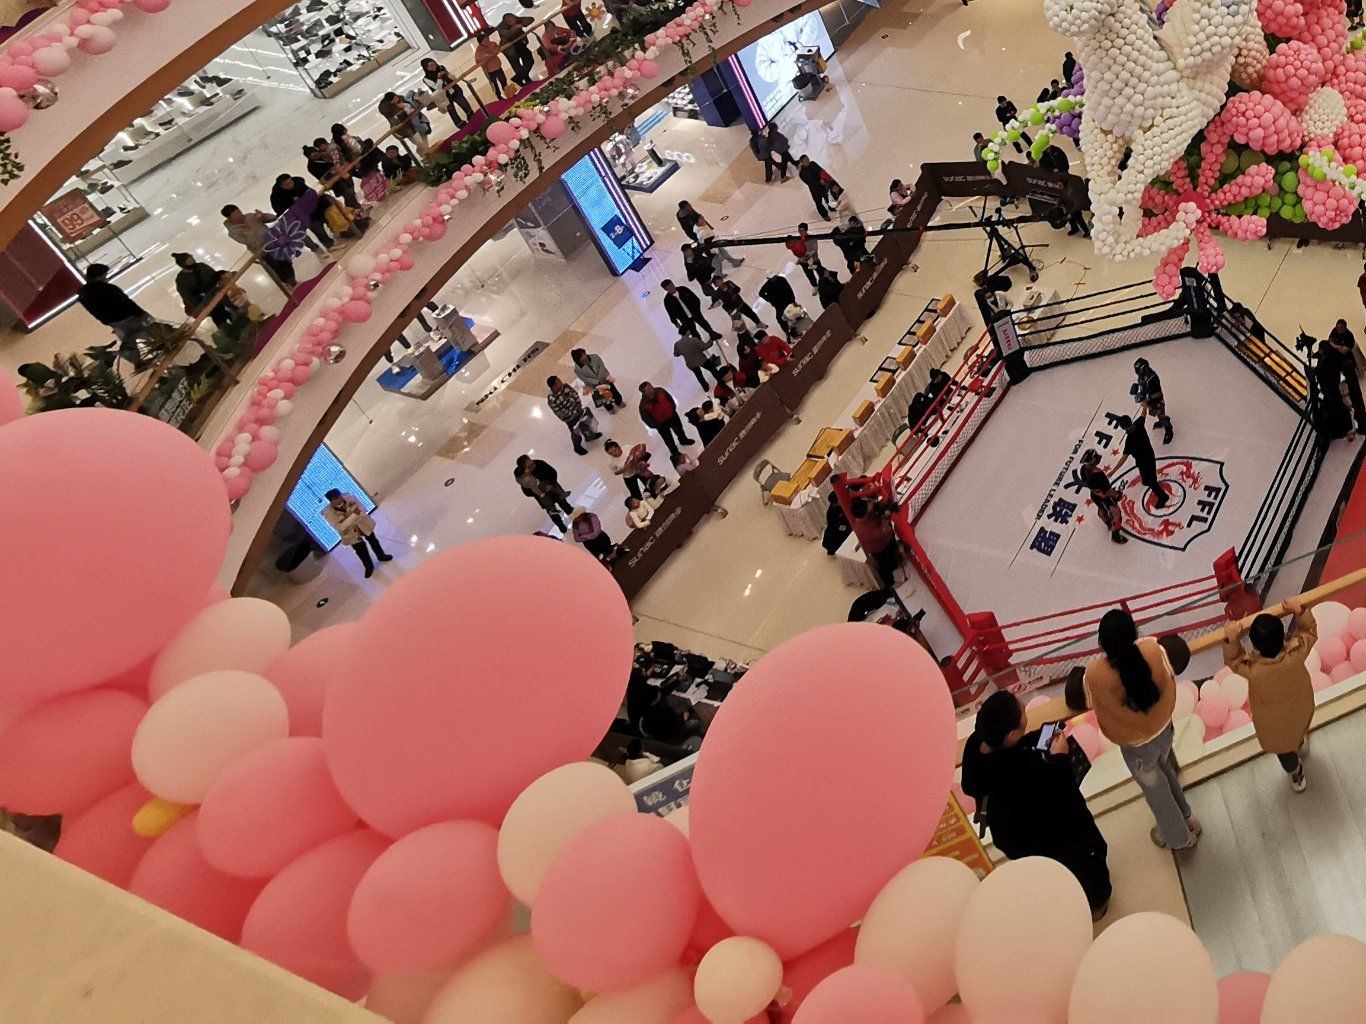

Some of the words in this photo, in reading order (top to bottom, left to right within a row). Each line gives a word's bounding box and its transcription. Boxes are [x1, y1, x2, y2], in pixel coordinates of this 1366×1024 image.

[715, 434, 742, 467] sunac
[1028, 411, 1120, 558] FF大联盟
[1052, 455, 1075, 487] FUTURE
[1186, 484, 1222, 529] FFL
